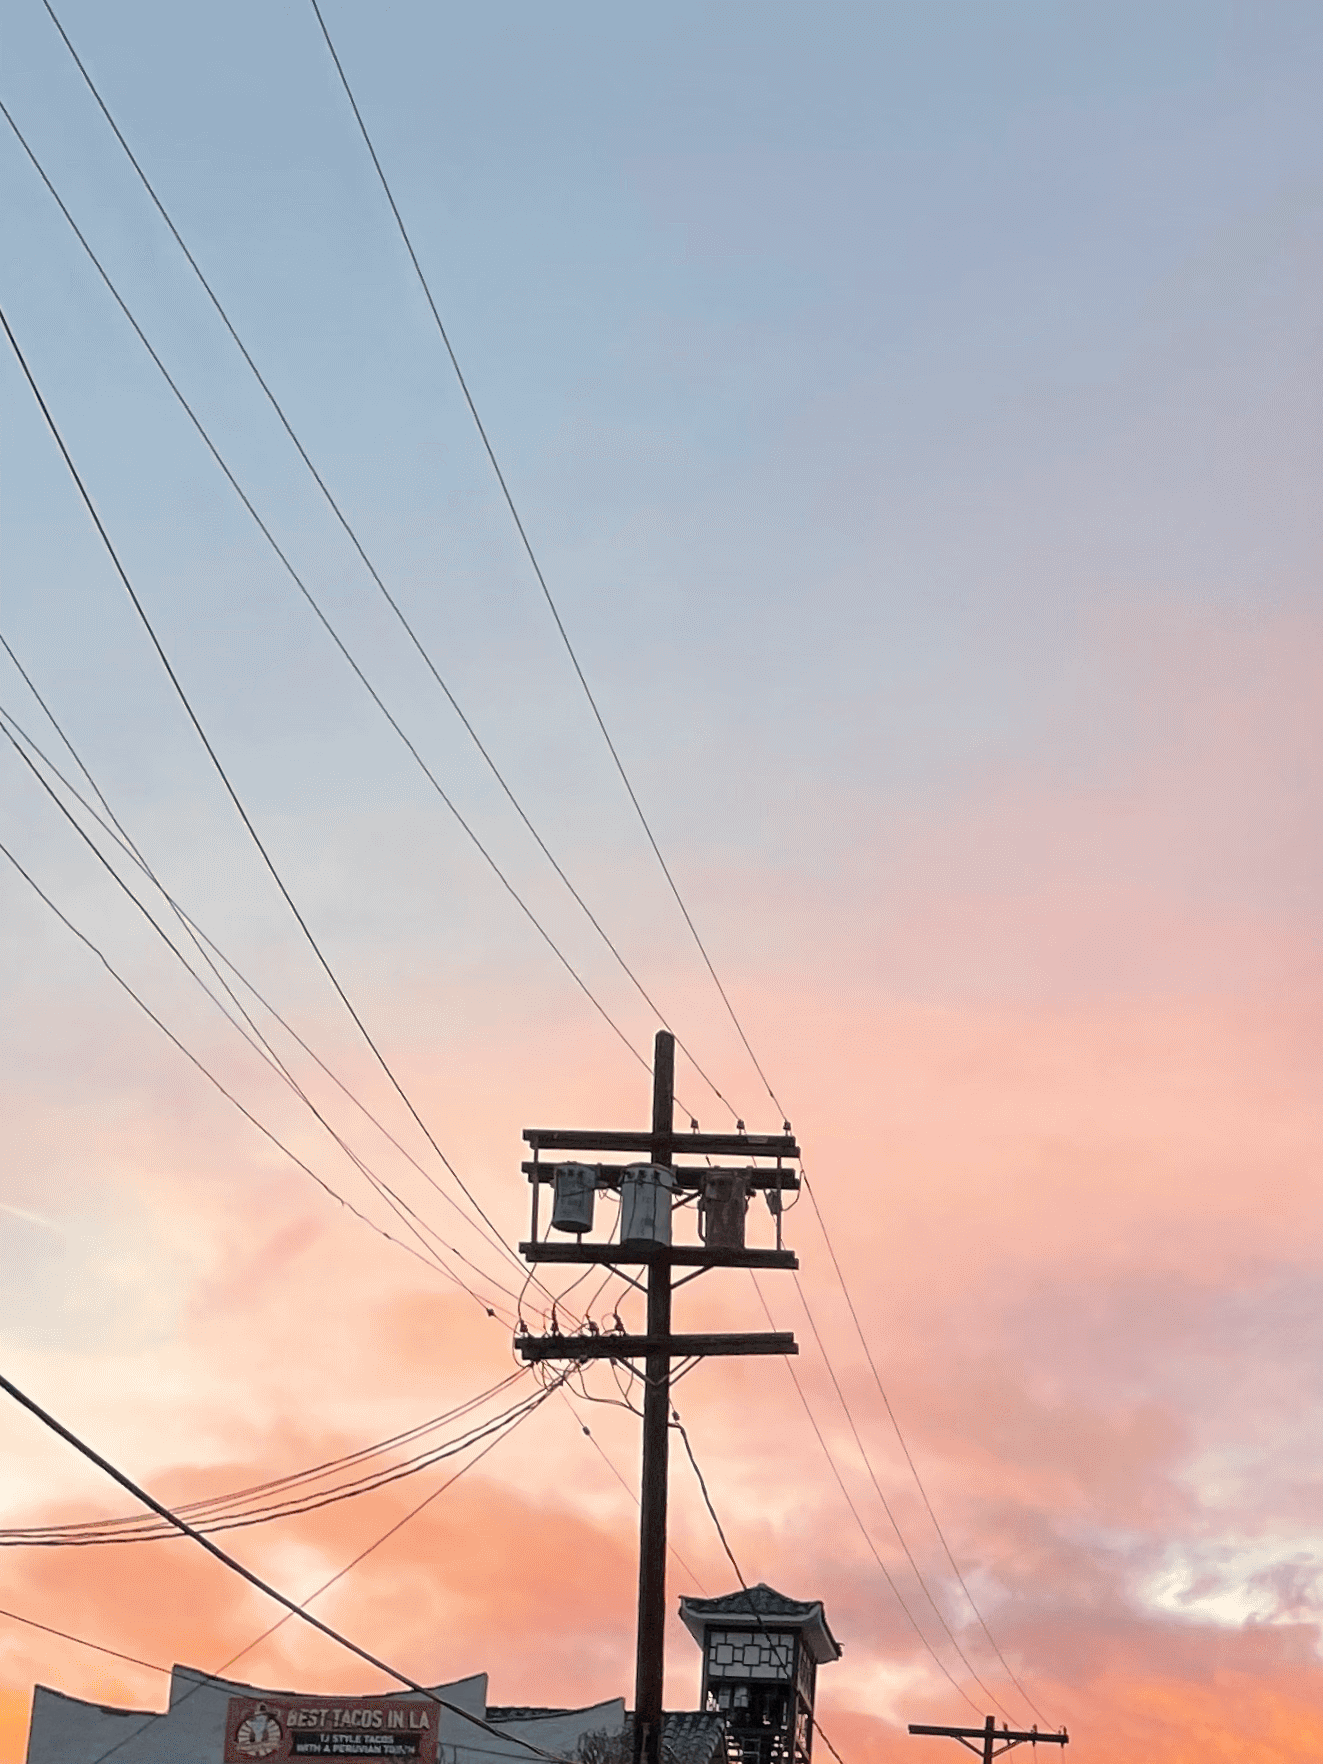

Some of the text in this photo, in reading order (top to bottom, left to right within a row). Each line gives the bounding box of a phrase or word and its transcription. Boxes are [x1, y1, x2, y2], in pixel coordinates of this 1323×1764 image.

[286, 1708, 431, 1730] BEST TACOS IN LA
[332, 1734, 362, 1744] STYLE
[364, 1735, 394, 1744] TACOS
[296, 1743, 321, 1753] WITH
[323, 1744, 331, 1753] A
[333, 1744, 381, 1754] PERUVIAN
